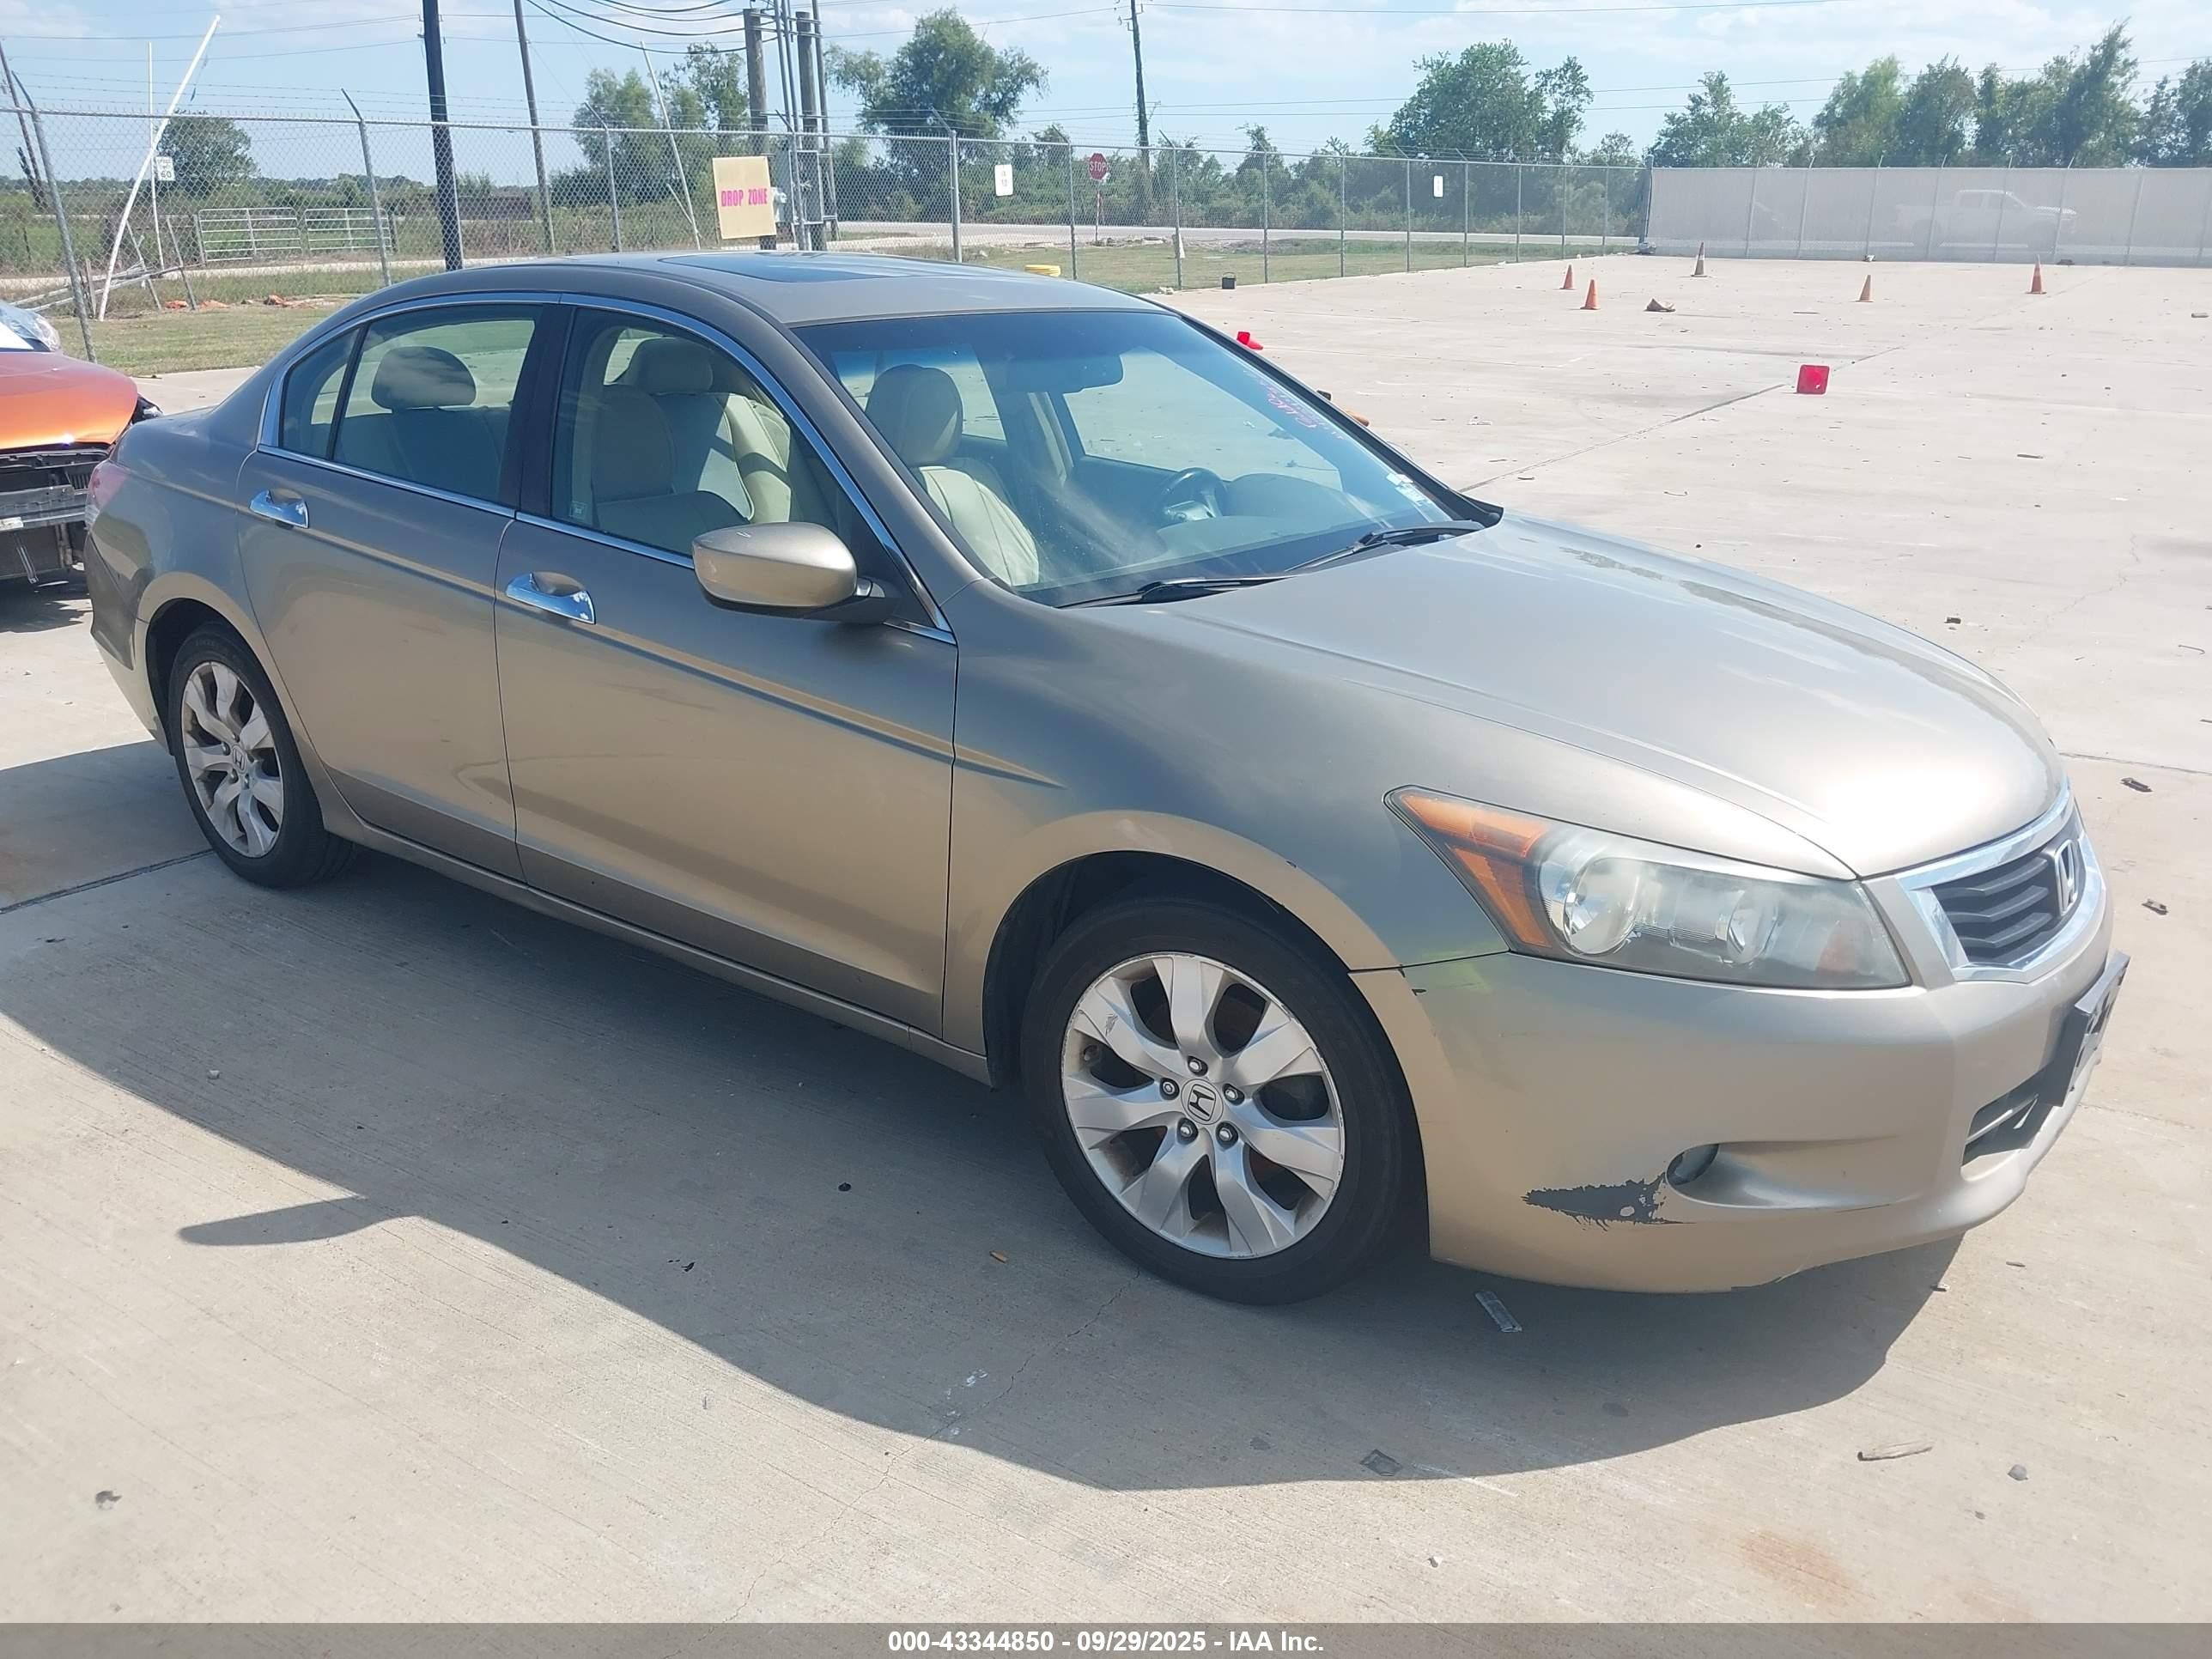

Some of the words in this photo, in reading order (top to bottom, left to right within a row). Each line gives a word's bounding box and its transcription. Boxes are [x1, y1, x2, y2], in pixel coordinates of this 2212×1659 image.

[1091, 161, 1106, 172] STOP
[721, 189, 744, 207] DROP
[748, 188, 768, 205] ZONE
